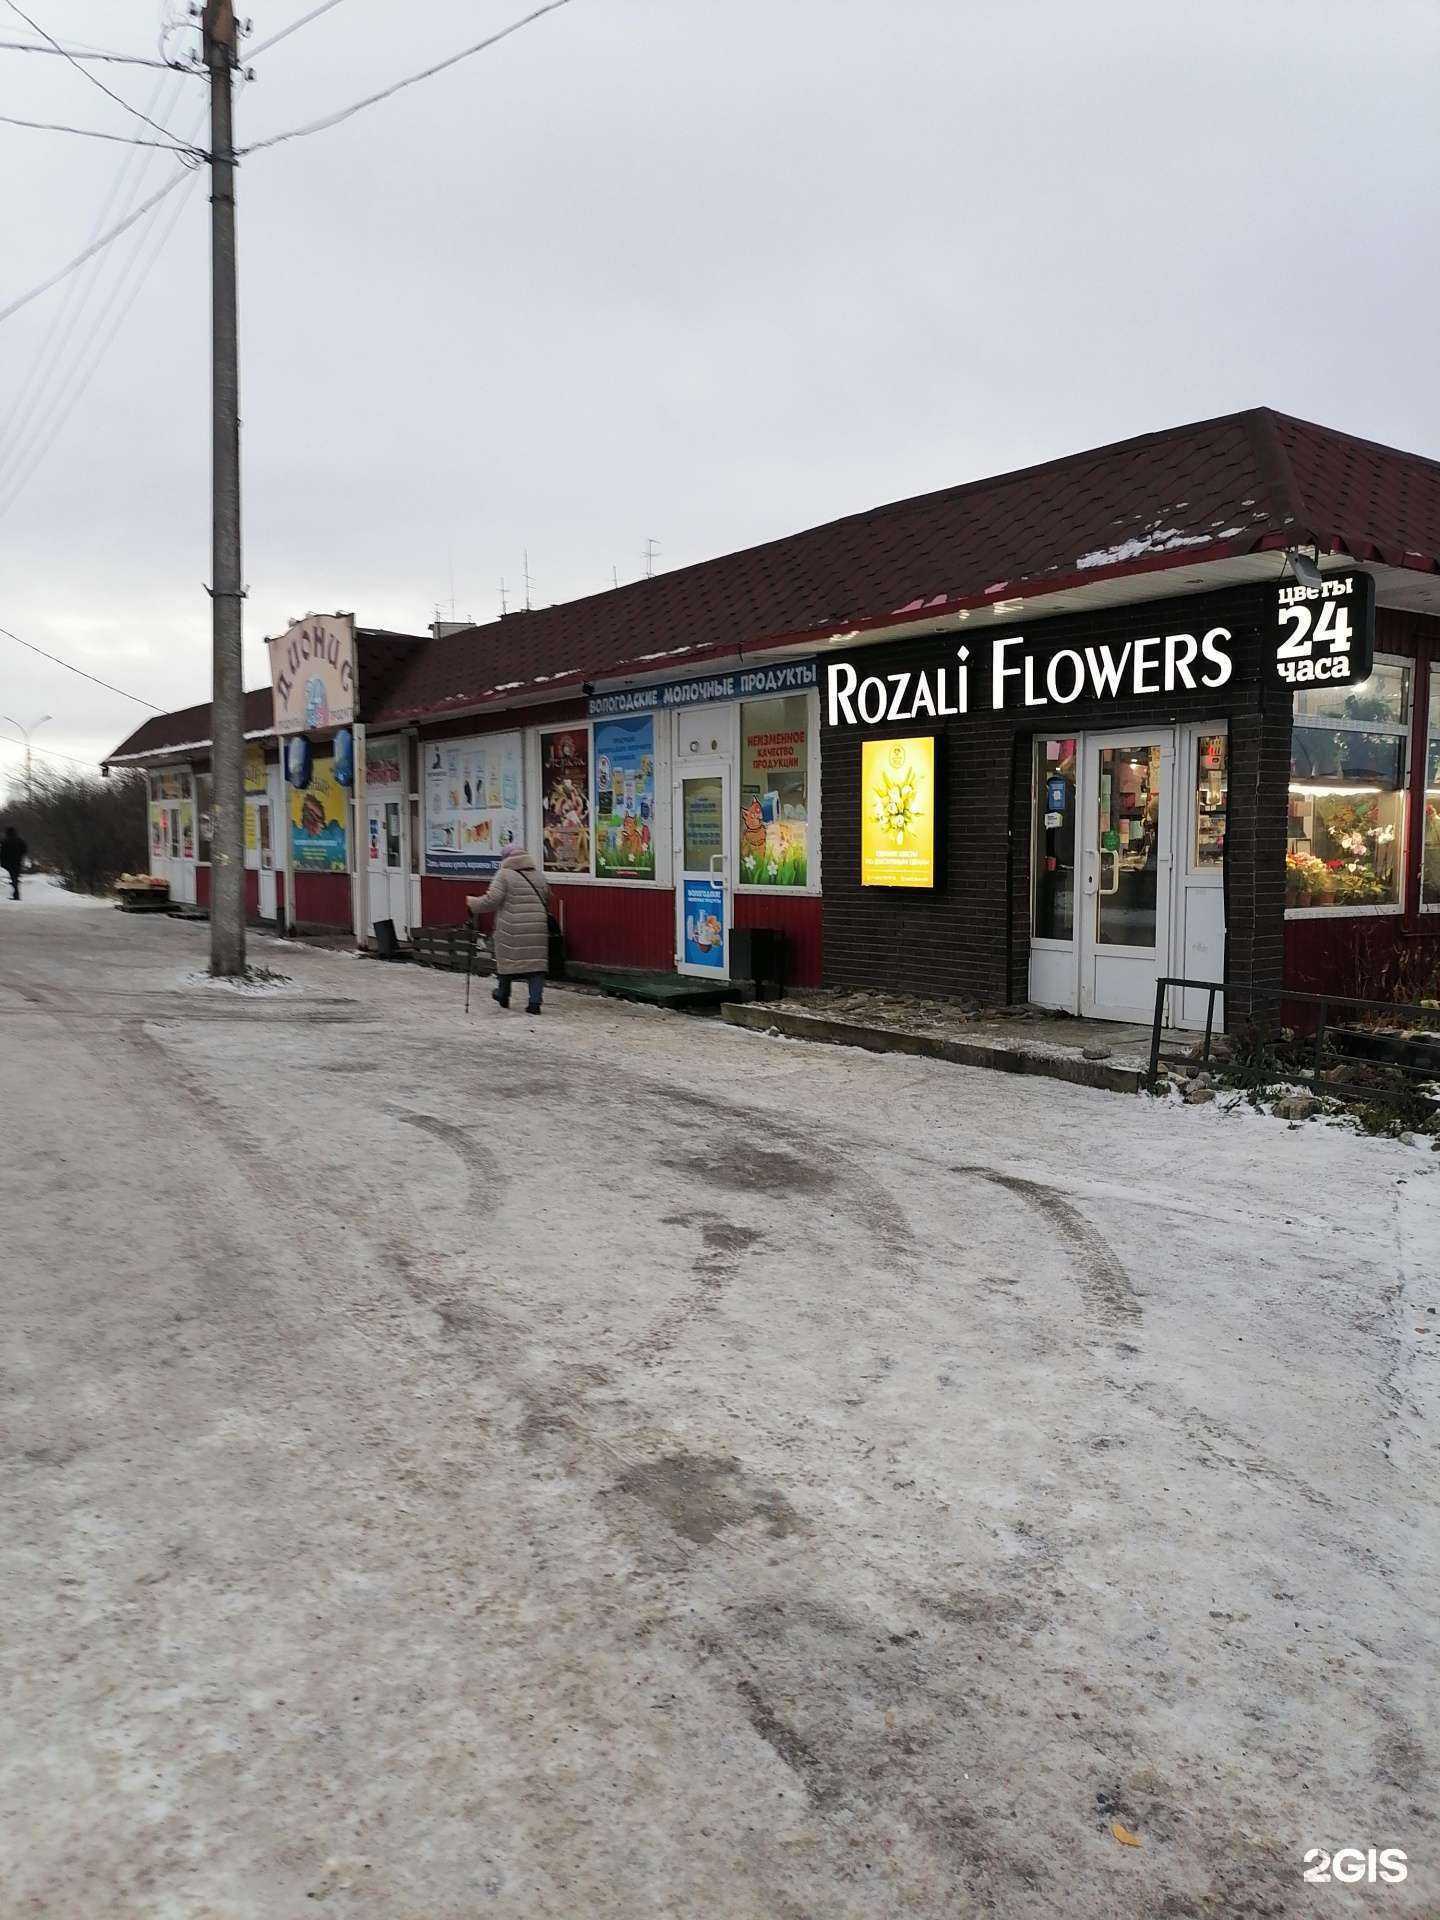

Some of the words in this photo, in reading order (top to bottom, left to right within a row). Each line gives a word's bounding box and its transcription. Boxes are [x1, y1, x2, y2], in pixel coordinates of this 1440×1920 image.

[1278, 577, 1353, 606] цветы
[1276, 601, 1353, 660] 24
[1276, 655, 1351, 683] часа
[588, 691, 659, 715] ВОЛОГОДСКИЕ
[663, 677, 735, 705] МОЛОЧНЫЕ
[740, 664, 817, 693] ПРОДУКТЫ
[747, 731, 805, 747] НЕИЗМЕННОЕ
[757, 746, 794, 757] КАЧЕСТВО
[752, 757, 799, 769] ПРОДУКЦИИ
